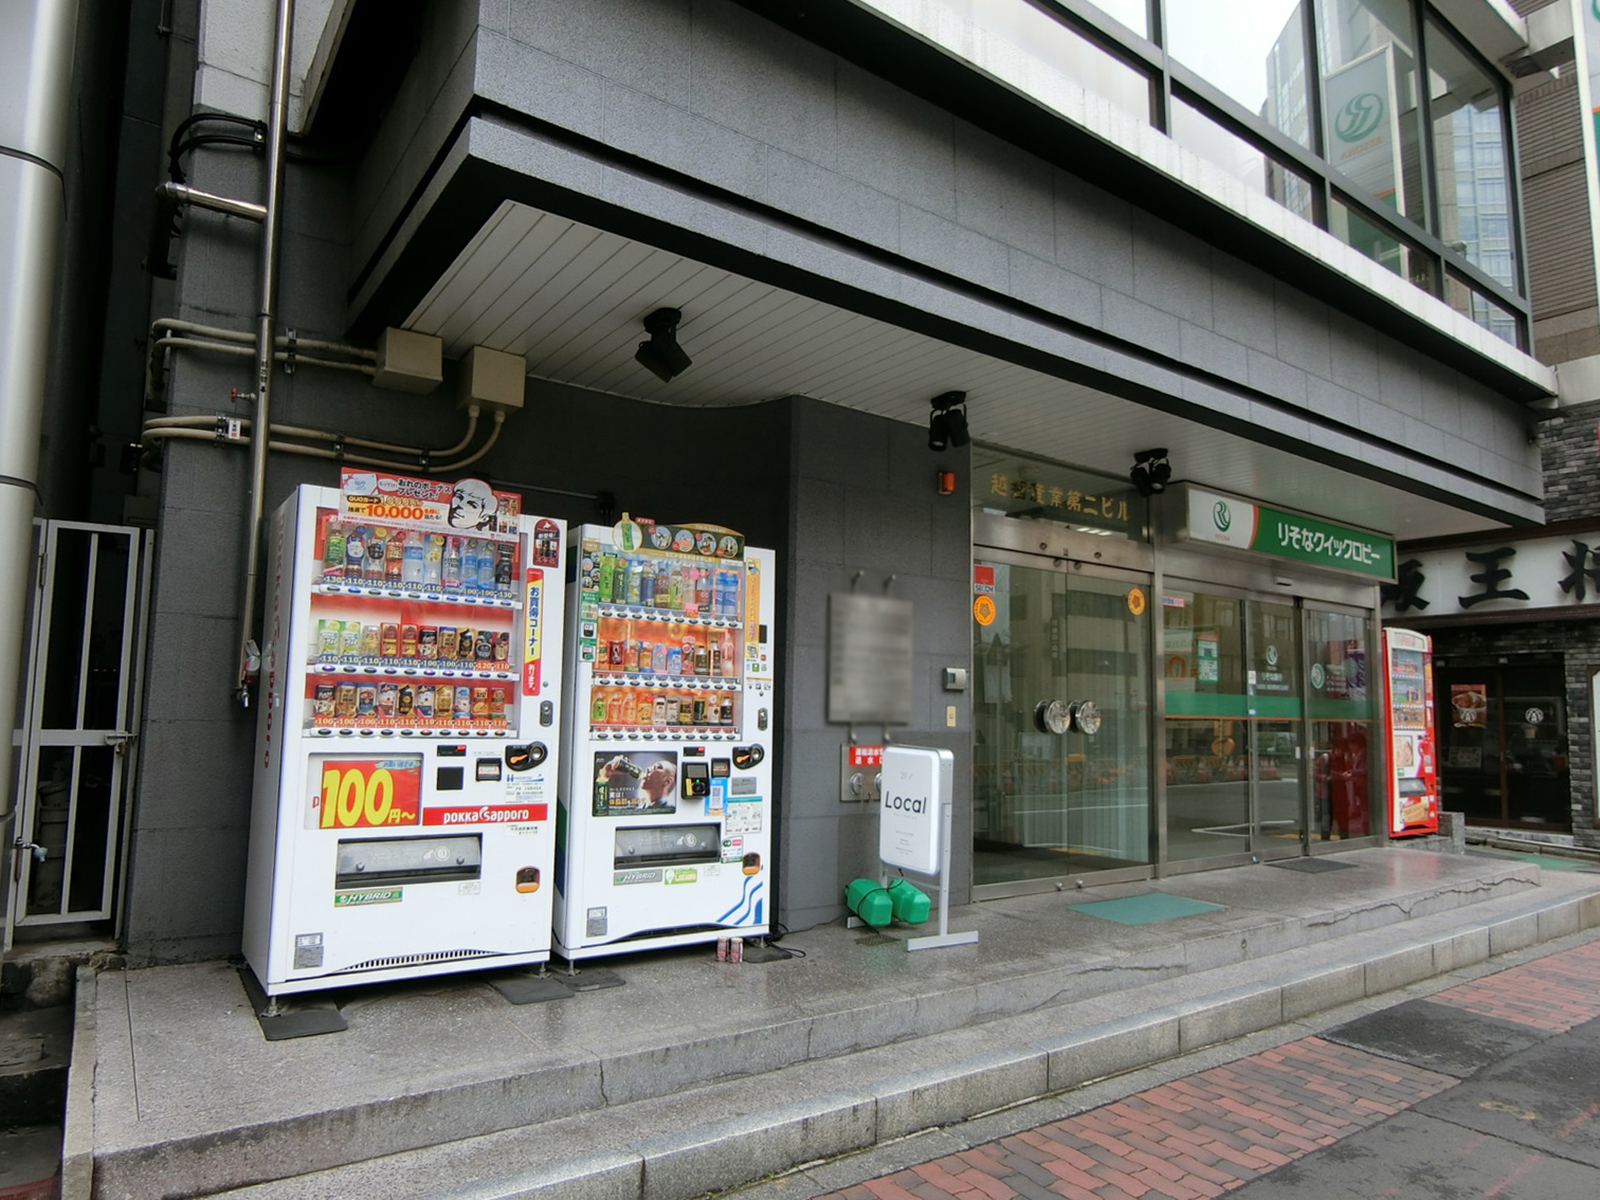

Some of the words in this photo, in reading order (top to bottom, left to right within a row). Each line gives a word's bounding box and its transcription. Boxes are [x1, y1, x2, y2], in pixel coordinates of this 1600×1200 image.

[398, 478, 452, 493] おれのボーナス
[398, 487, 439, 499] プレゼント!
[366, 504, 424, 520] 10,000
[1277, 522, 1381, 565] りそなクイックロビー
[885, 790, 928, 815] Local
[622, 872, 656, 884] HYBRID
[346, 891, 392, 905] HYBRID
